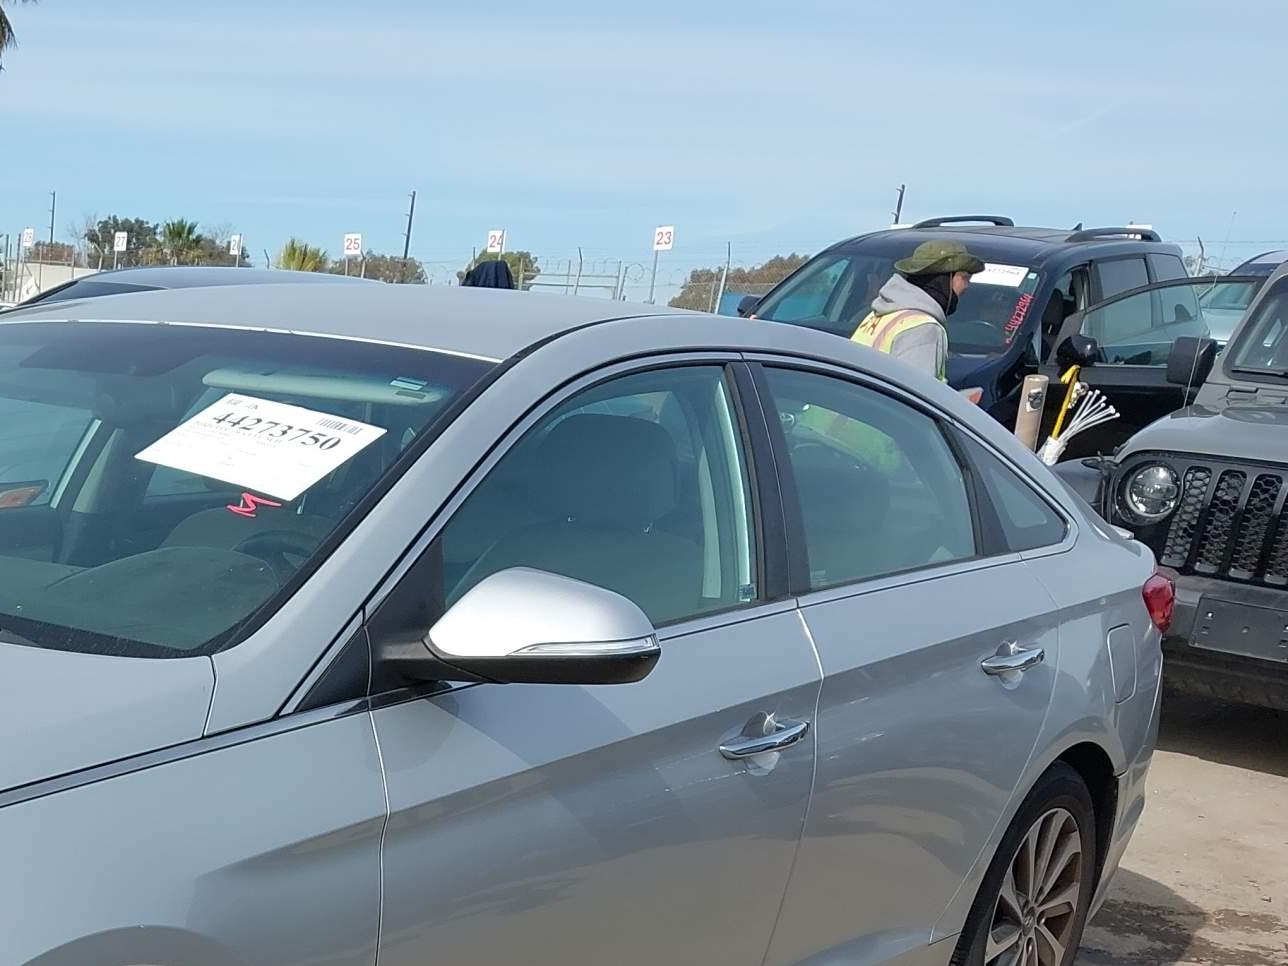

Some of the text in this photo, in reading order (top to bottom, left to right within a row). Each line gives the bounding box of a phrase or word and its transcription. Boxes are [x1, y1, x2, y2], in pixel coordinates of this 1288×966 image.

[345, 237, 360, 251] 25
[656, 231, 672, 245] 23
[212, 412, 342, 451] 44273750
